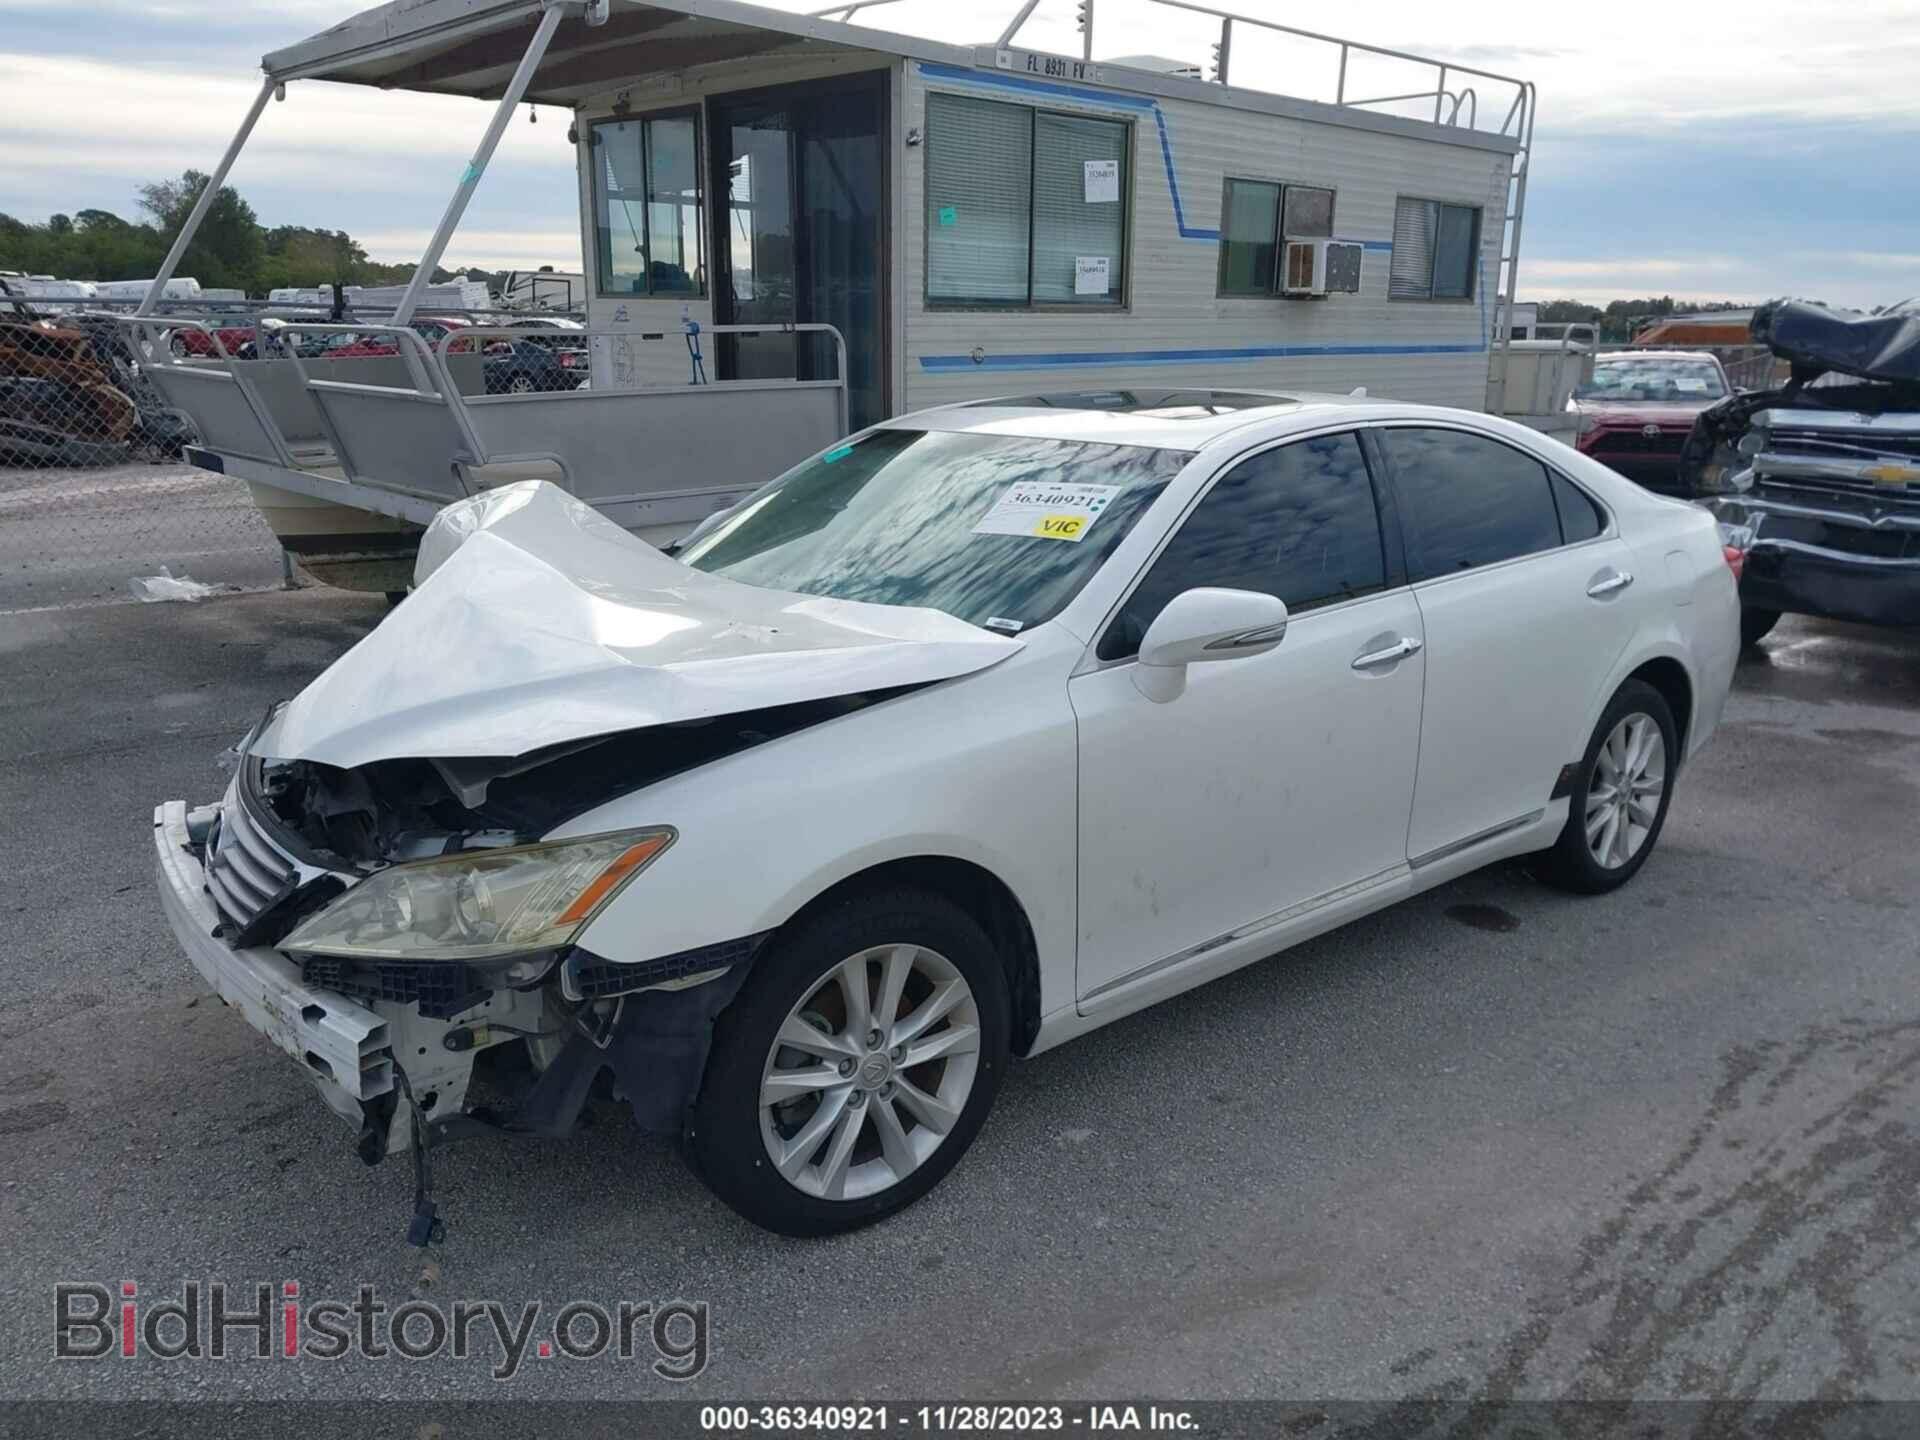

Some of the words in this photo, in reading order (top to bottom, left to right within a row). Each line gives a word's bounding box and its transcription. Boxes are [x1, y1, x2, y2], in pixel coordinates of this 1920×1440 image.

[1027, 54, 1038, 72] FL
[1073, 62, 1085, 79] FV
[1009, 493, 1096, 507] 36340921
[1044, 520, 1080, 534] VIC
